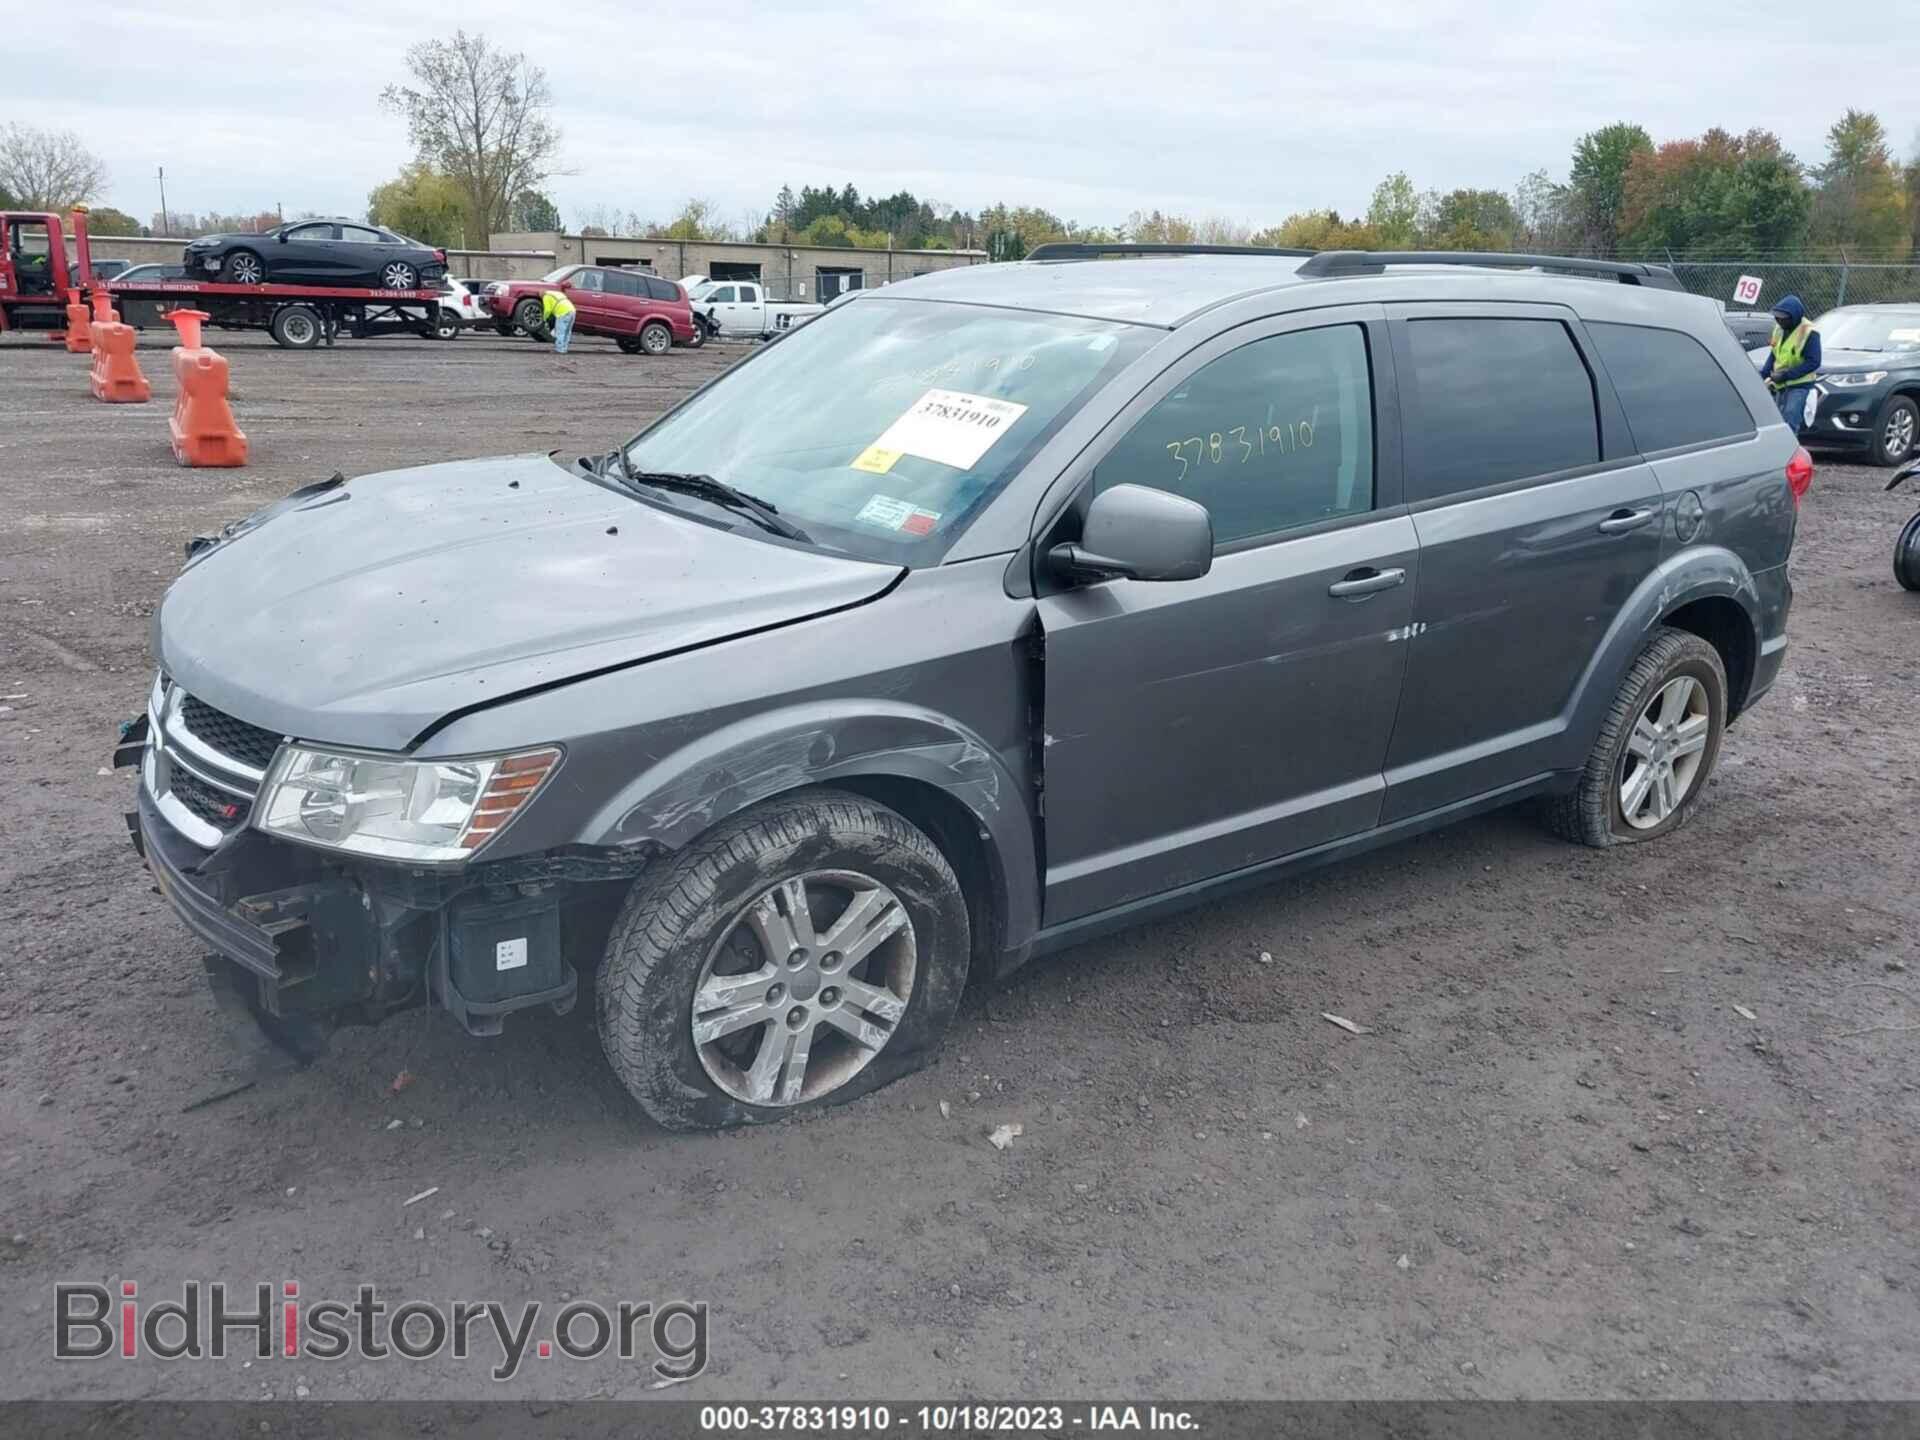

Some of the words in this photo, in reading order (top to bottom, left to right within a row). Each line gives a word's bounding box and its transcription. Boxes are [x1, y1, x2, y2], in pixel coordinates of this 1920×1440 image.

[1740, 281, 1758, 299] 19
[917, 402, 1001, 428] 37831910
[1166, 421, 1313, 480] 37831910
